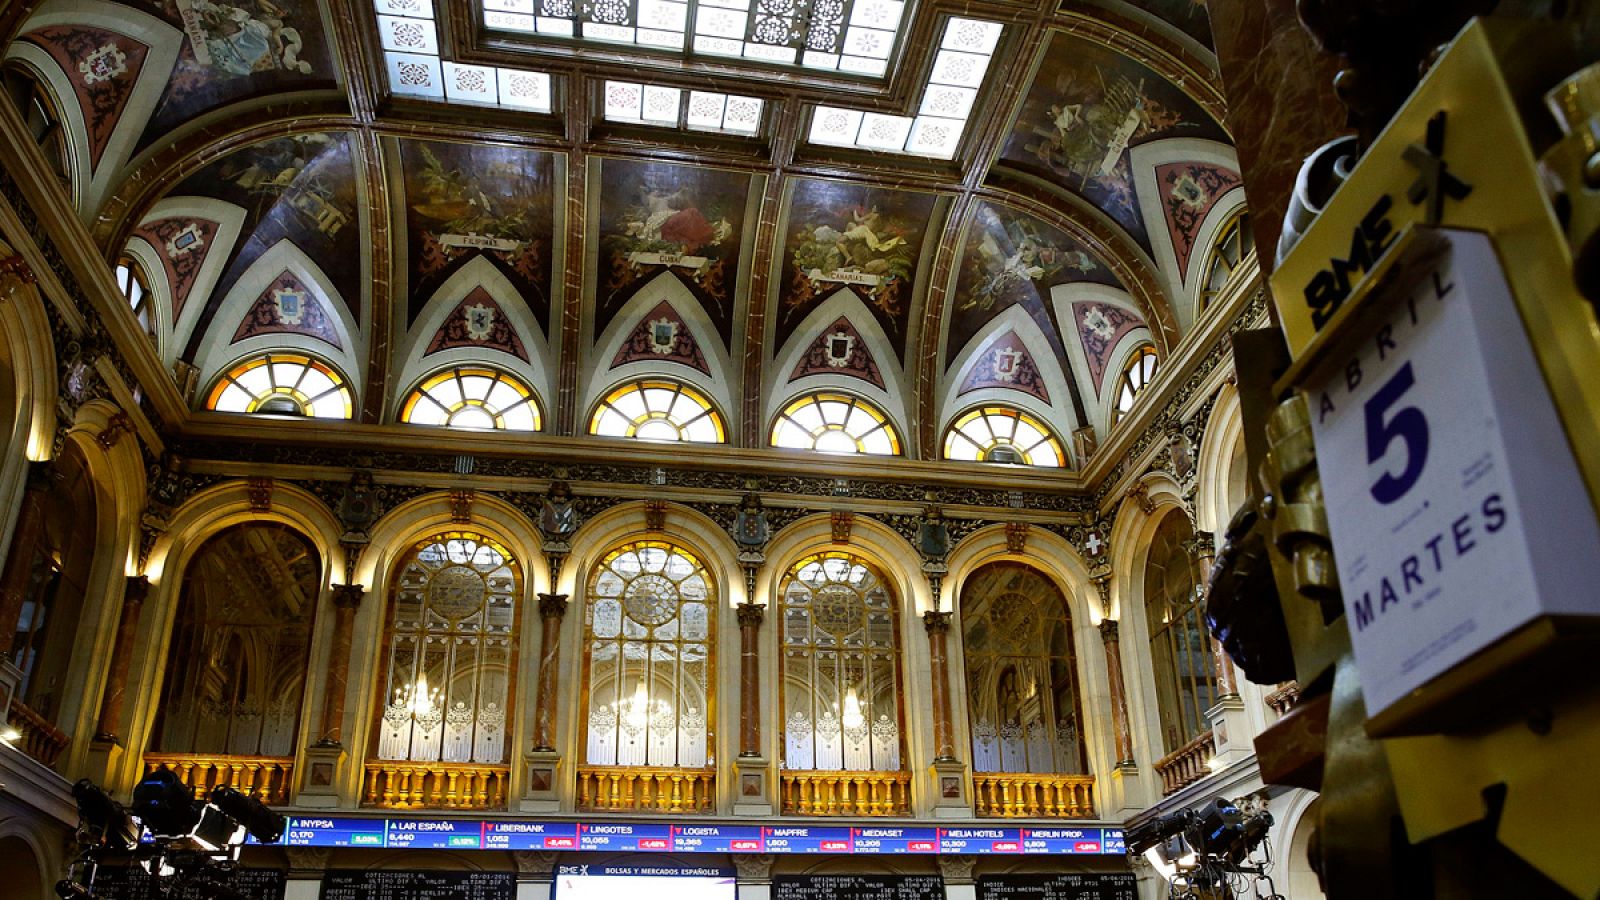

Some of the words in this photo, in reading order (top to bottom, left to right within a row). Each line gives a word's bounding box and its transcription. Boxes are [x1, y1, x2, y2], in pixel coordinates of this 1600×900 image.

[1318, 271, 1455, 424] ABRIL
[1363, 360, 1430, 505] 5
[1353, 492, 1508, 632] MARTES
[300, 820, 334, 829] INYPSA
[398, 822, 416, 830] LAR
[418, 820, 454, 831] ESPAÑA
[495, 823, 545, 832] LIBERBANK
[590, 826, 633, 834] LINGOTES
[683, 827, 719, 836] LOGISTA
[774, 828, 808, 837] MAPFRE
[862, 829, 903, 837] MEDIASET
[948, 830, 972, 838] MELIA
[973, 830, 1004, 838] HOTELS
[1031, 830, 1060, 838] MERLIN
[1061, 830, 1085, 838] PROP.
[605, 867, 632, 875] BOLSAS
[641, 868, 678, 876] MERCADOS
[681, 867, 720, 876] ESPAÑOLES
